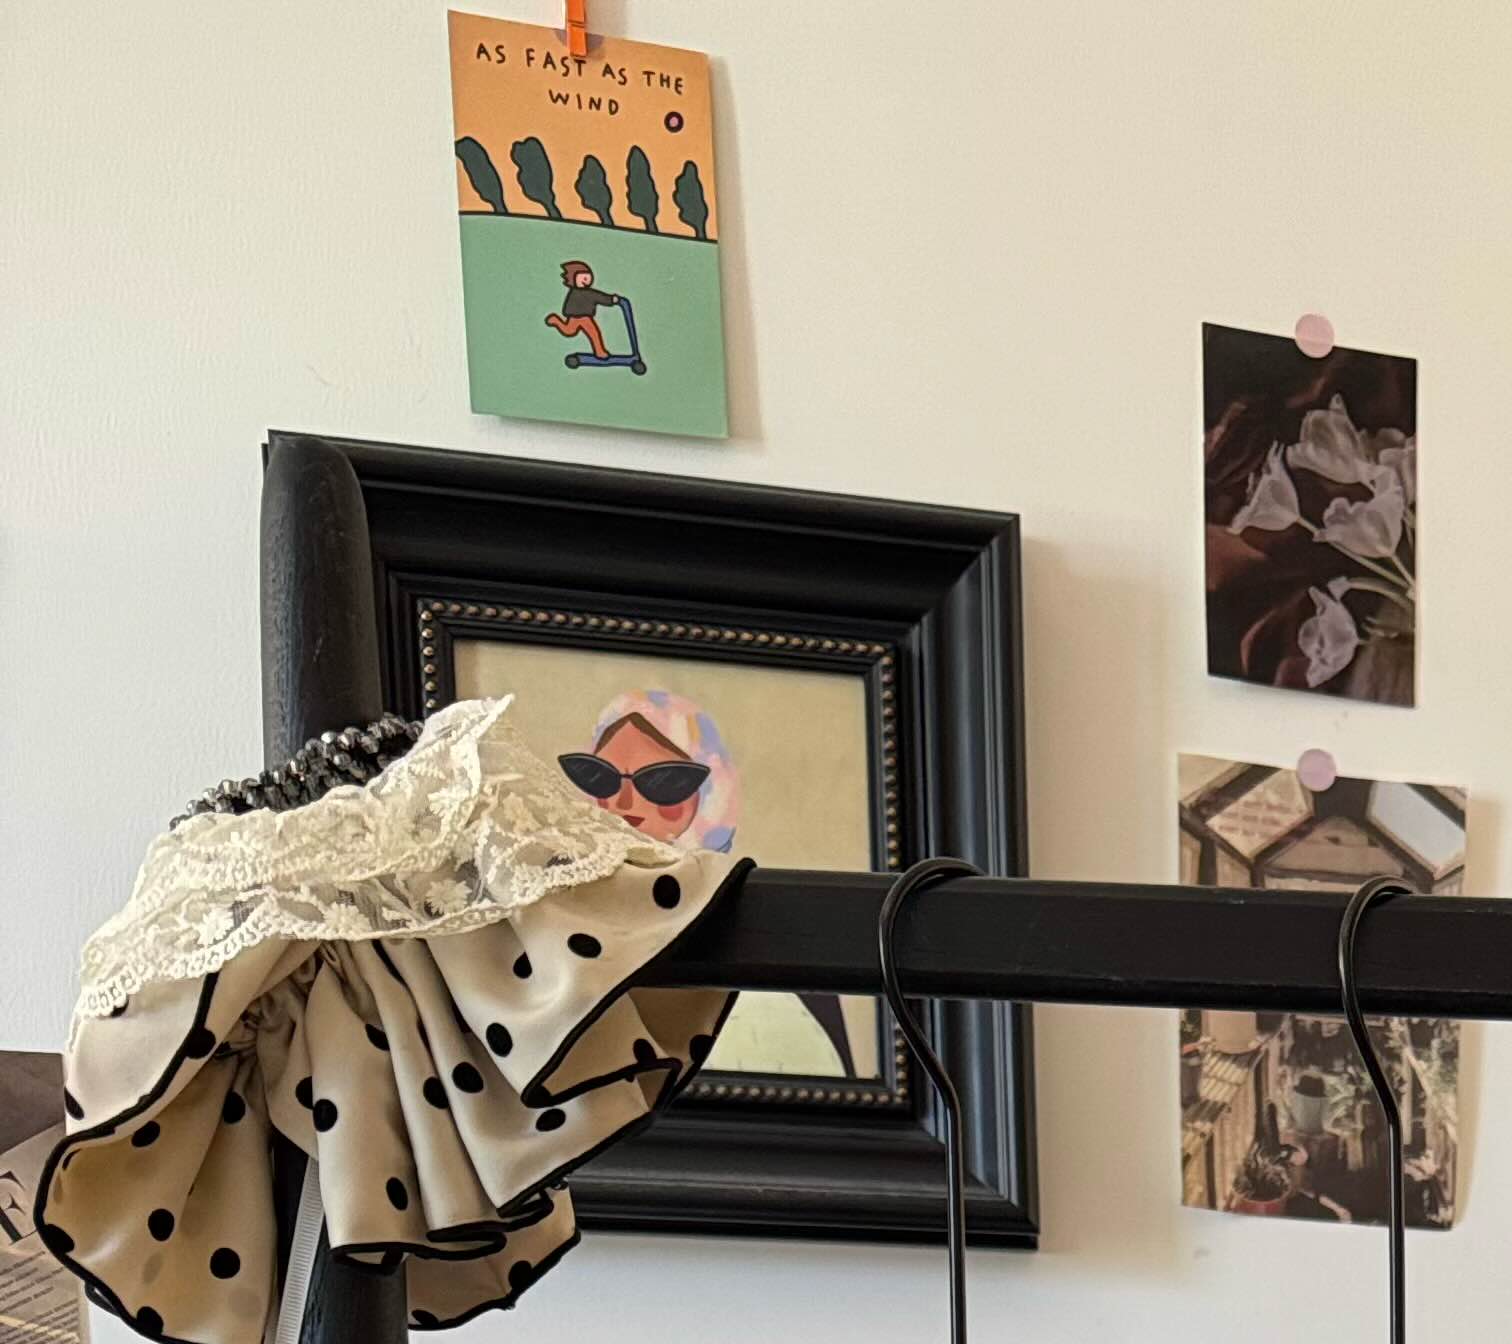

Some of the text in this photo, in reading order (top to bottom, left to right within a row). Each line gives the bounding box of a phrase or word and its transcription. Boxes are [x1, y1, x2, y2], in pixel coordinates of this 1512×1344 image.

[476, 42, 685, 95] AS FAST AS THE
[549, 88, 620, 116] WIND
